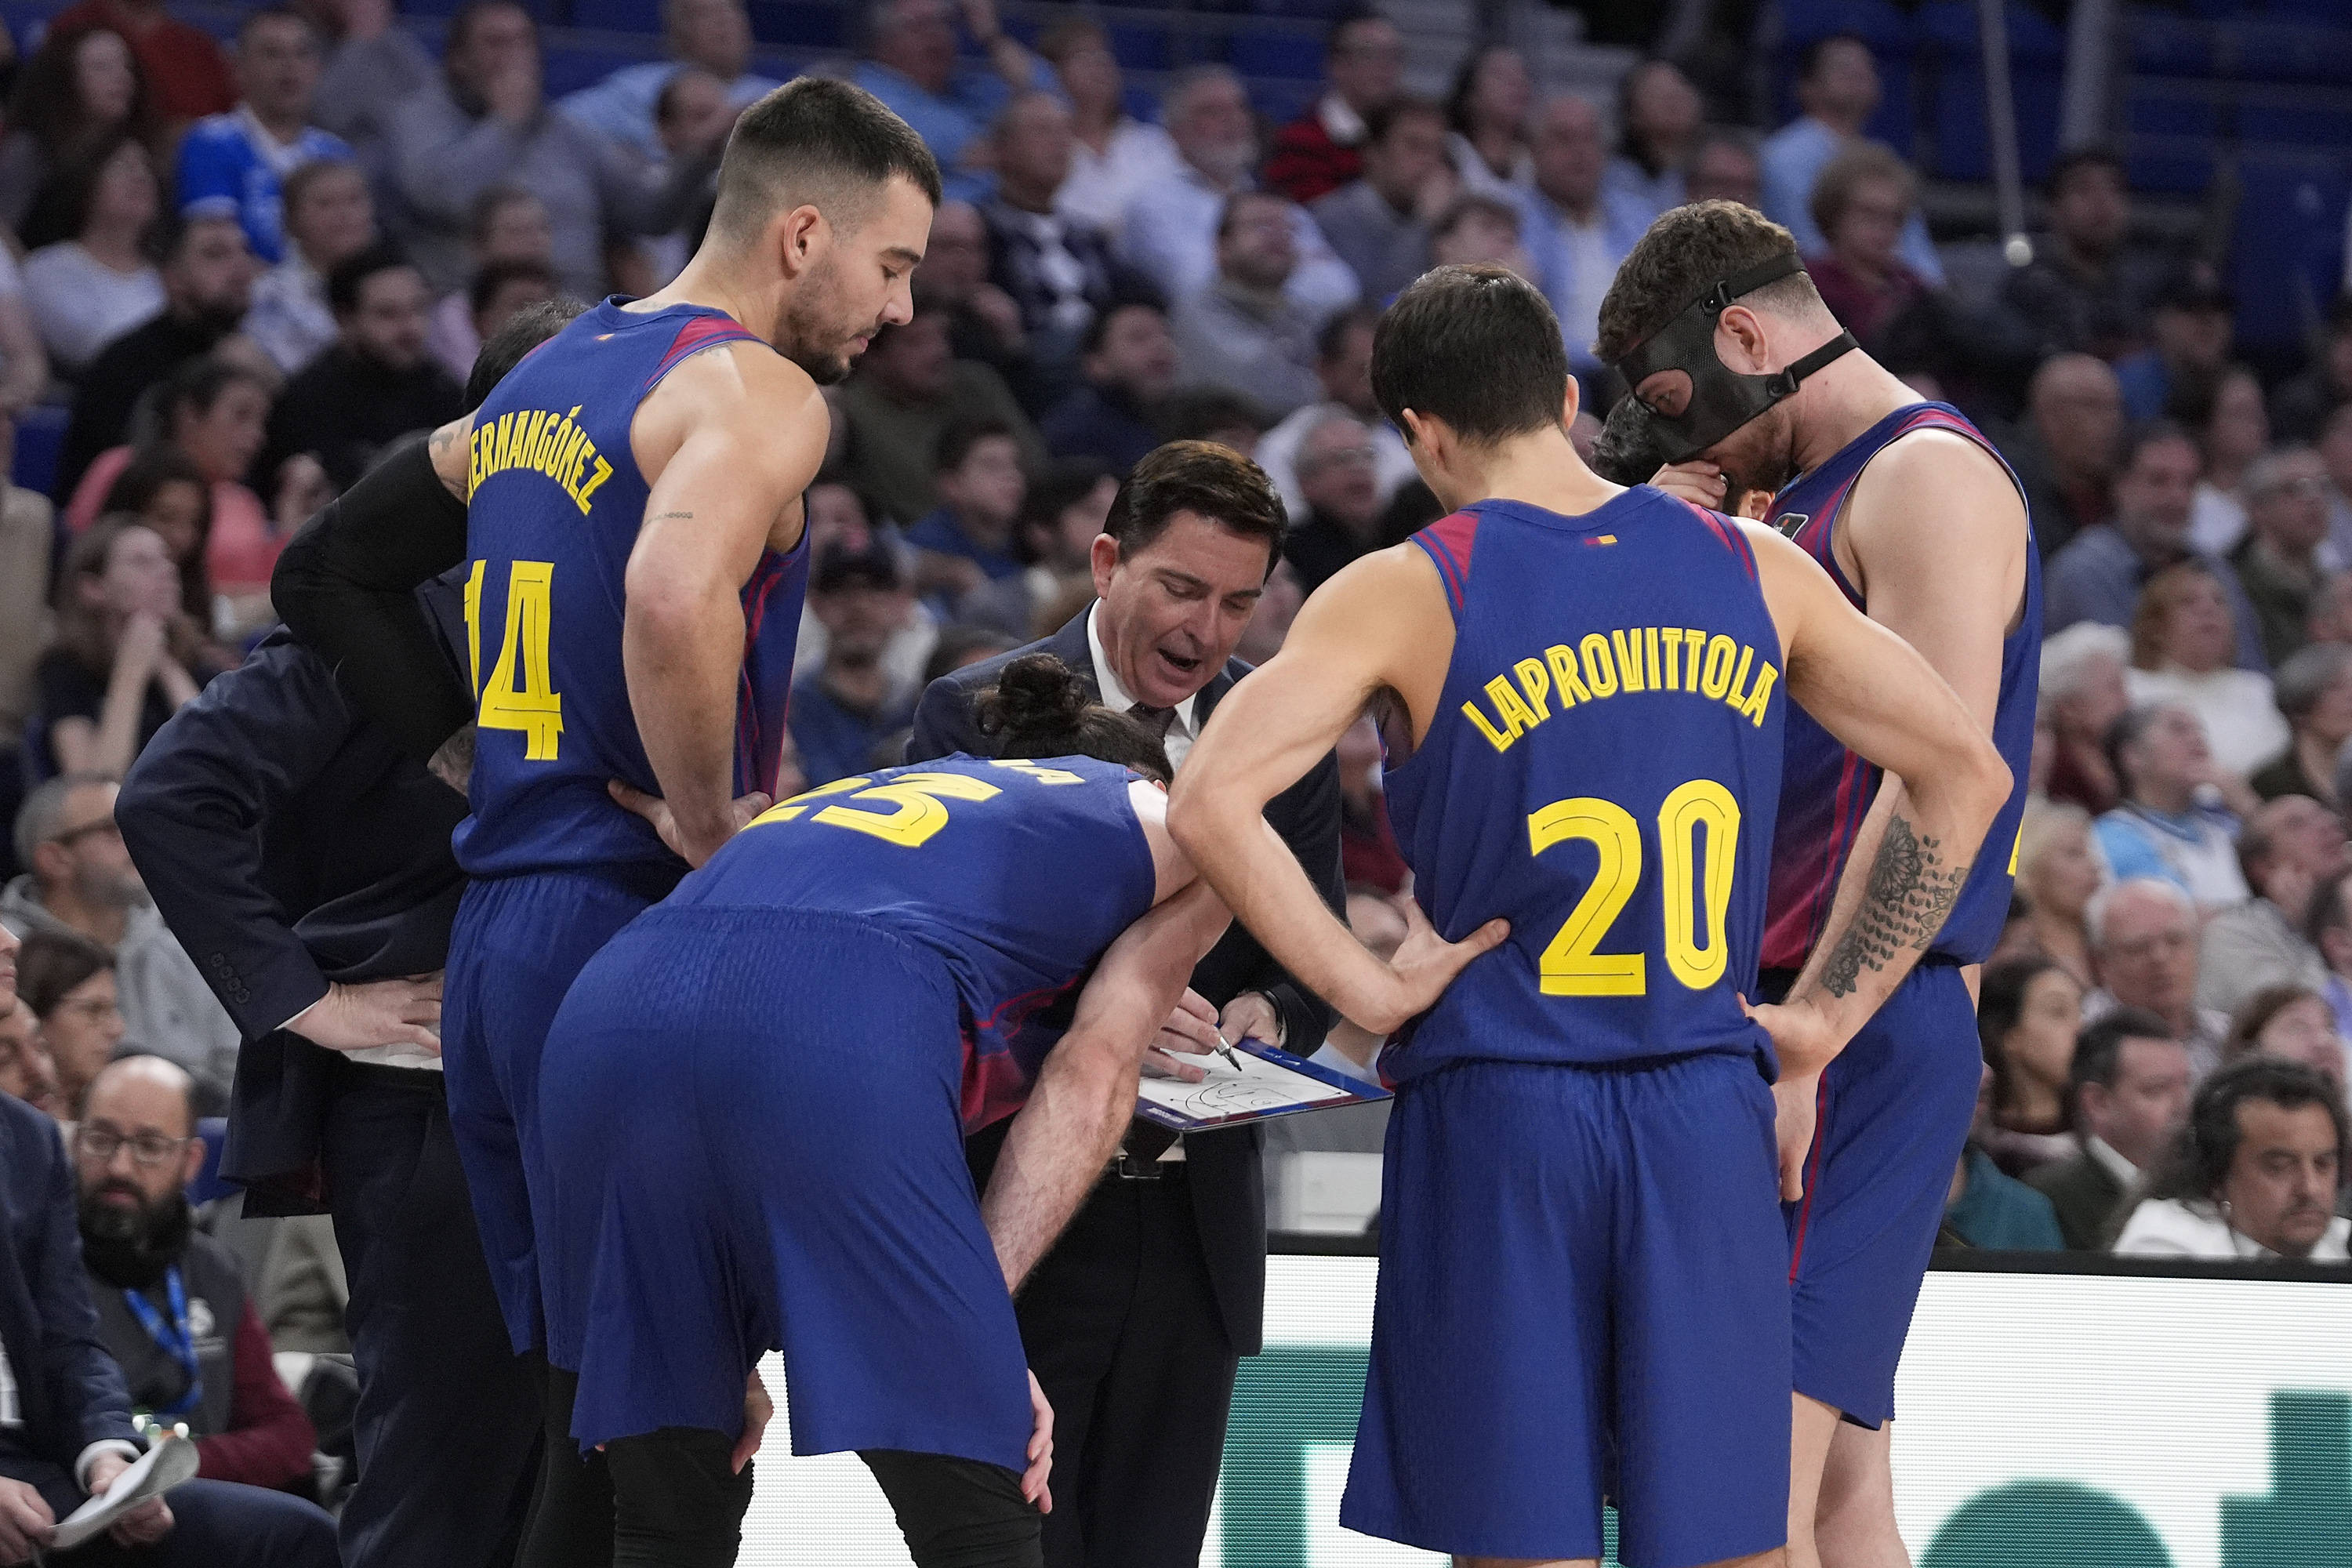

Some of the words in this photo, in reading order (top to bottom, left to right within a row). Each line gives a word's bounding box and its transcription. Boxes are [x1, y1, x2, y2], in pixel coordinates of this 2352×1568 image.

[464, 559, 564, 760] 14
[1461, 627, 1778, 753] LAPROVITTOLA
[1527, 779, 1740, 996] 20
